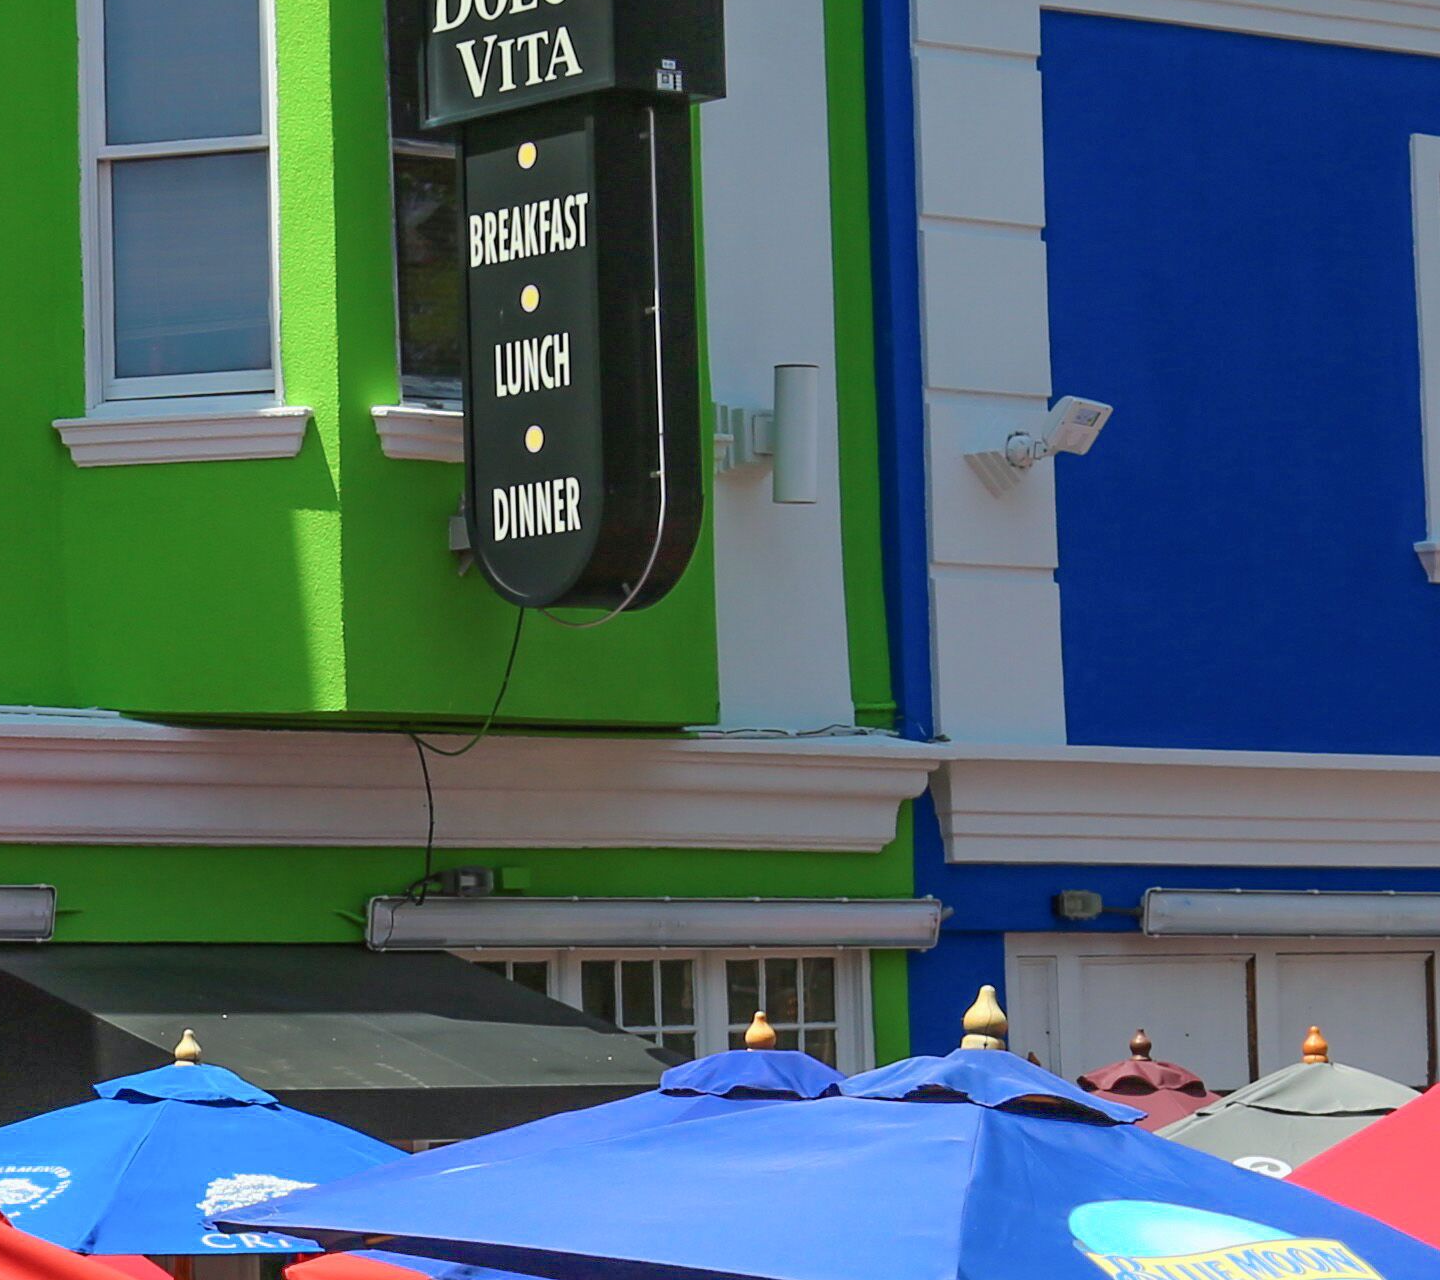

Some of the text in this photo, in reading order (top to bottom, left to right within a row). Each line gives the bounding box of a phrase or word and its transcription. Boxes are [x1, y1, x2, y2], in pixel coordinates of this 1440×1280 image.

[457, 25, 584, 99] VITA
[469, 193, 589, 270] BREAKFAST
[494, 334, 571, 398] LUNCH
[492, 477, 583, 543] DINNER
